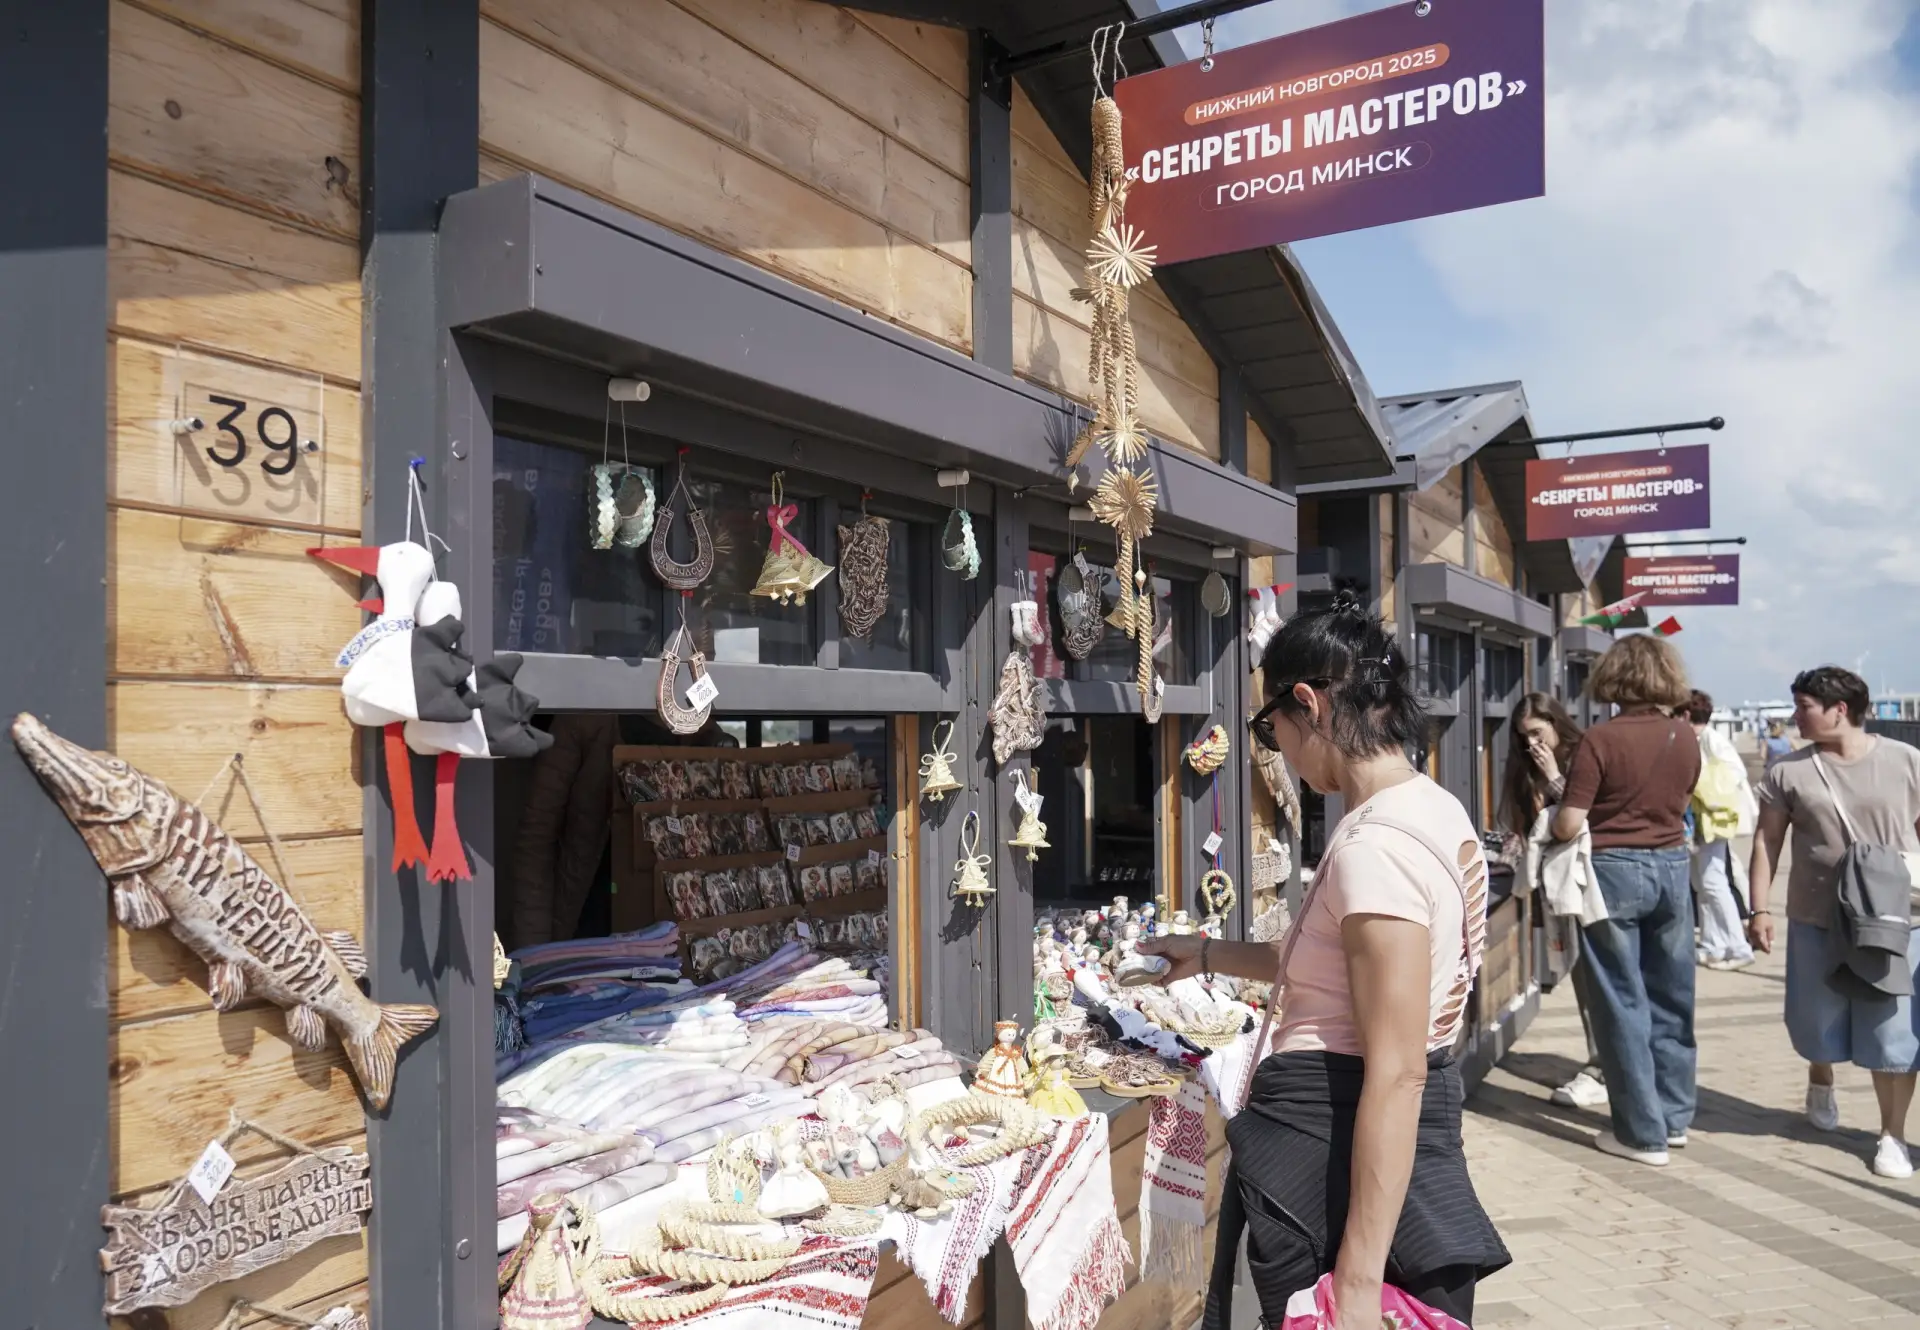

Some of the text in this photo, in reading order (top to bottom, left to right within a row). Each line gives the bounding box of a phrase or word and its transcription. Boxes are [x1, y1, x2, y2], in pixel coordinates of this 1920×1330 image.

[1195, 48, 1436, 120] НИЖНИЙ НОВГОРОД 2025
[1124, 71, 1527, 184] «СЕКРЕТЫ МАСТЕРОВ»
[1216, 146, 1413, 205] ГОРОД МИНСК
[206, 394, 297, 475] 39
[1531, 478, 1704, 506] «СЕКРЕТЫ МАСТЕРОВ»
[1574, 503, 1659, 518] ГОРОД МИНСК
[168, 835, 223, 897] НИ
[127, 1182, 371, 1293] ЗДОРОВЬЕ ДАРИТ!
[159, 1160, 348, 1248] БАНЯ ПАРИТ
